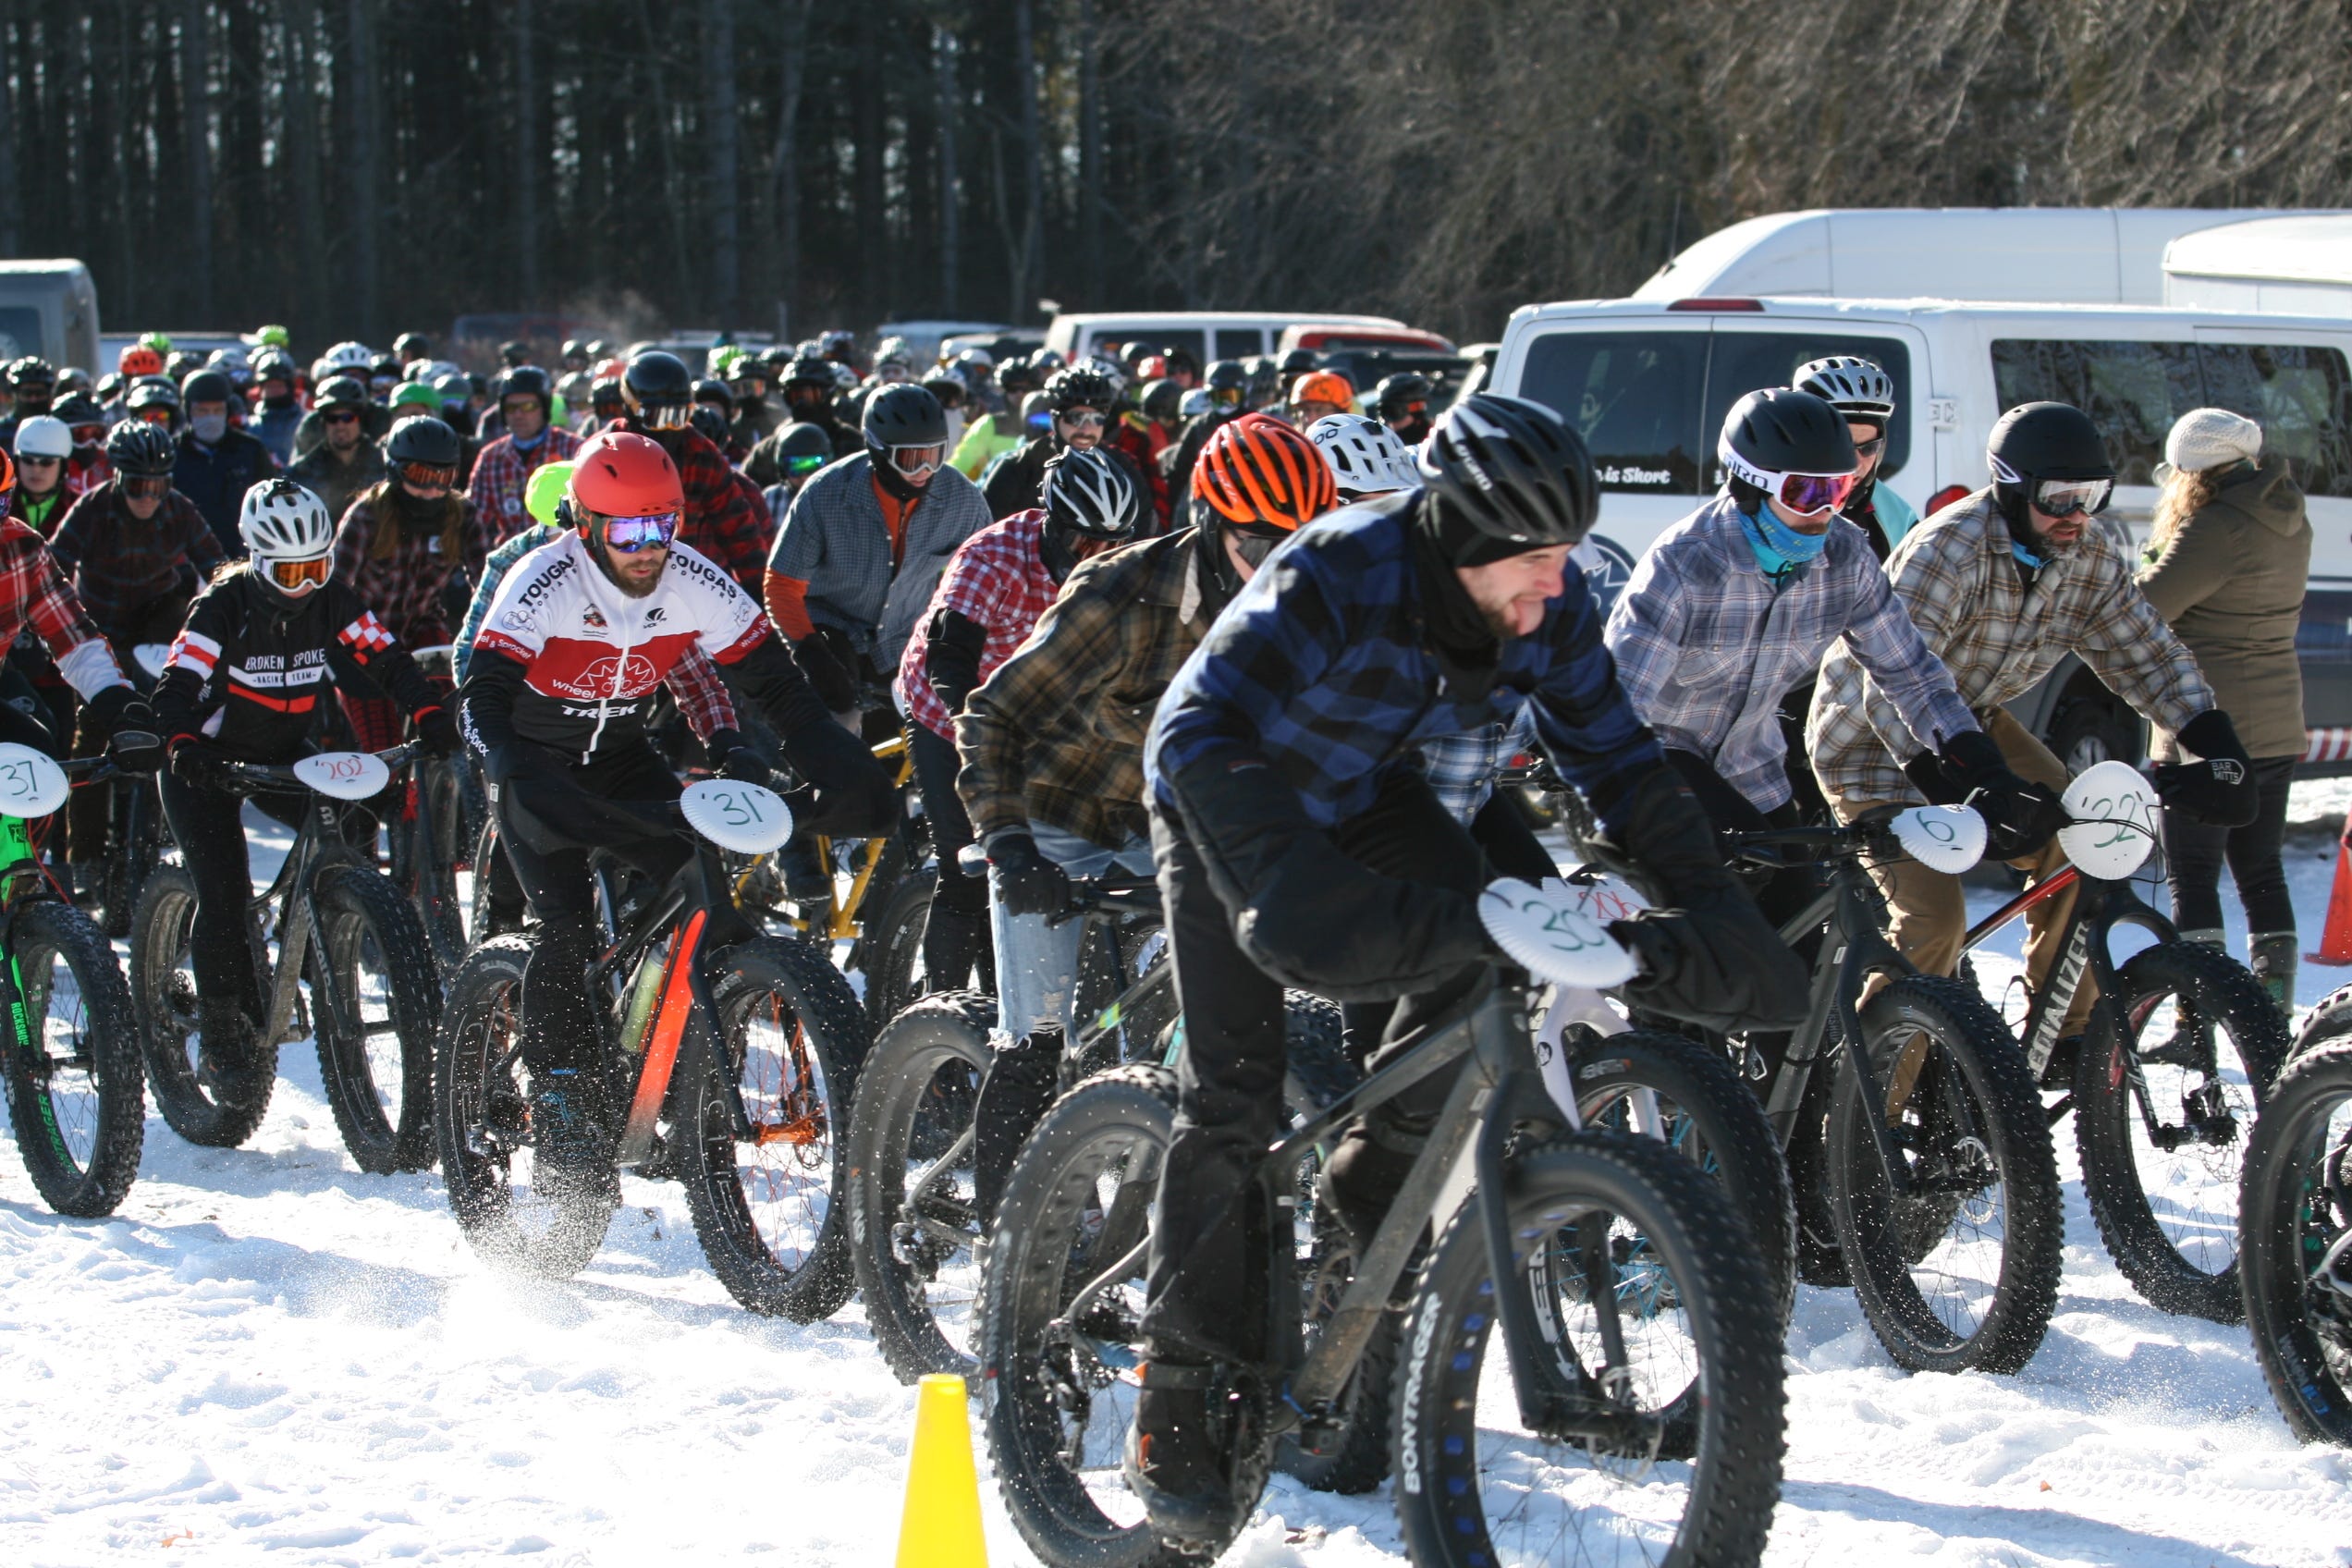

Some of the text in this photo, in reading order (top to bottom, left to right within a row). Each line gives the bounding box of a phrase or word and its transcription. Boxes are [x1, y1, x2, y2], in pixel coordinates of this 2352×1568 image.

[1604, 465, 1620, 483] is
[1622, 467, 1672, 484] Short
[1722, 452, 1769, 490] GIRO
[668, 550, 737, 599] TOUGAS
[244, 647, 326, 671] BROKEN SPOKE
[497, 638, 533, 660] Sprocket
[551, 679, 596, 700] wheel
[560, 703, 640, 720] TREK
[0, 760, 38, 796] 37
[321, 757, 370, 780] 202
[2211, 761, 2233, 771] BAR
[2212, 770, 2239, 783] MITTS
[713, 790, 764, 826] 31
[2091, 792, 2138, 850] 32
[1522, 899, 1607, 952] 30
[1401, 1292, 1442, 1495] BONTRAGER
